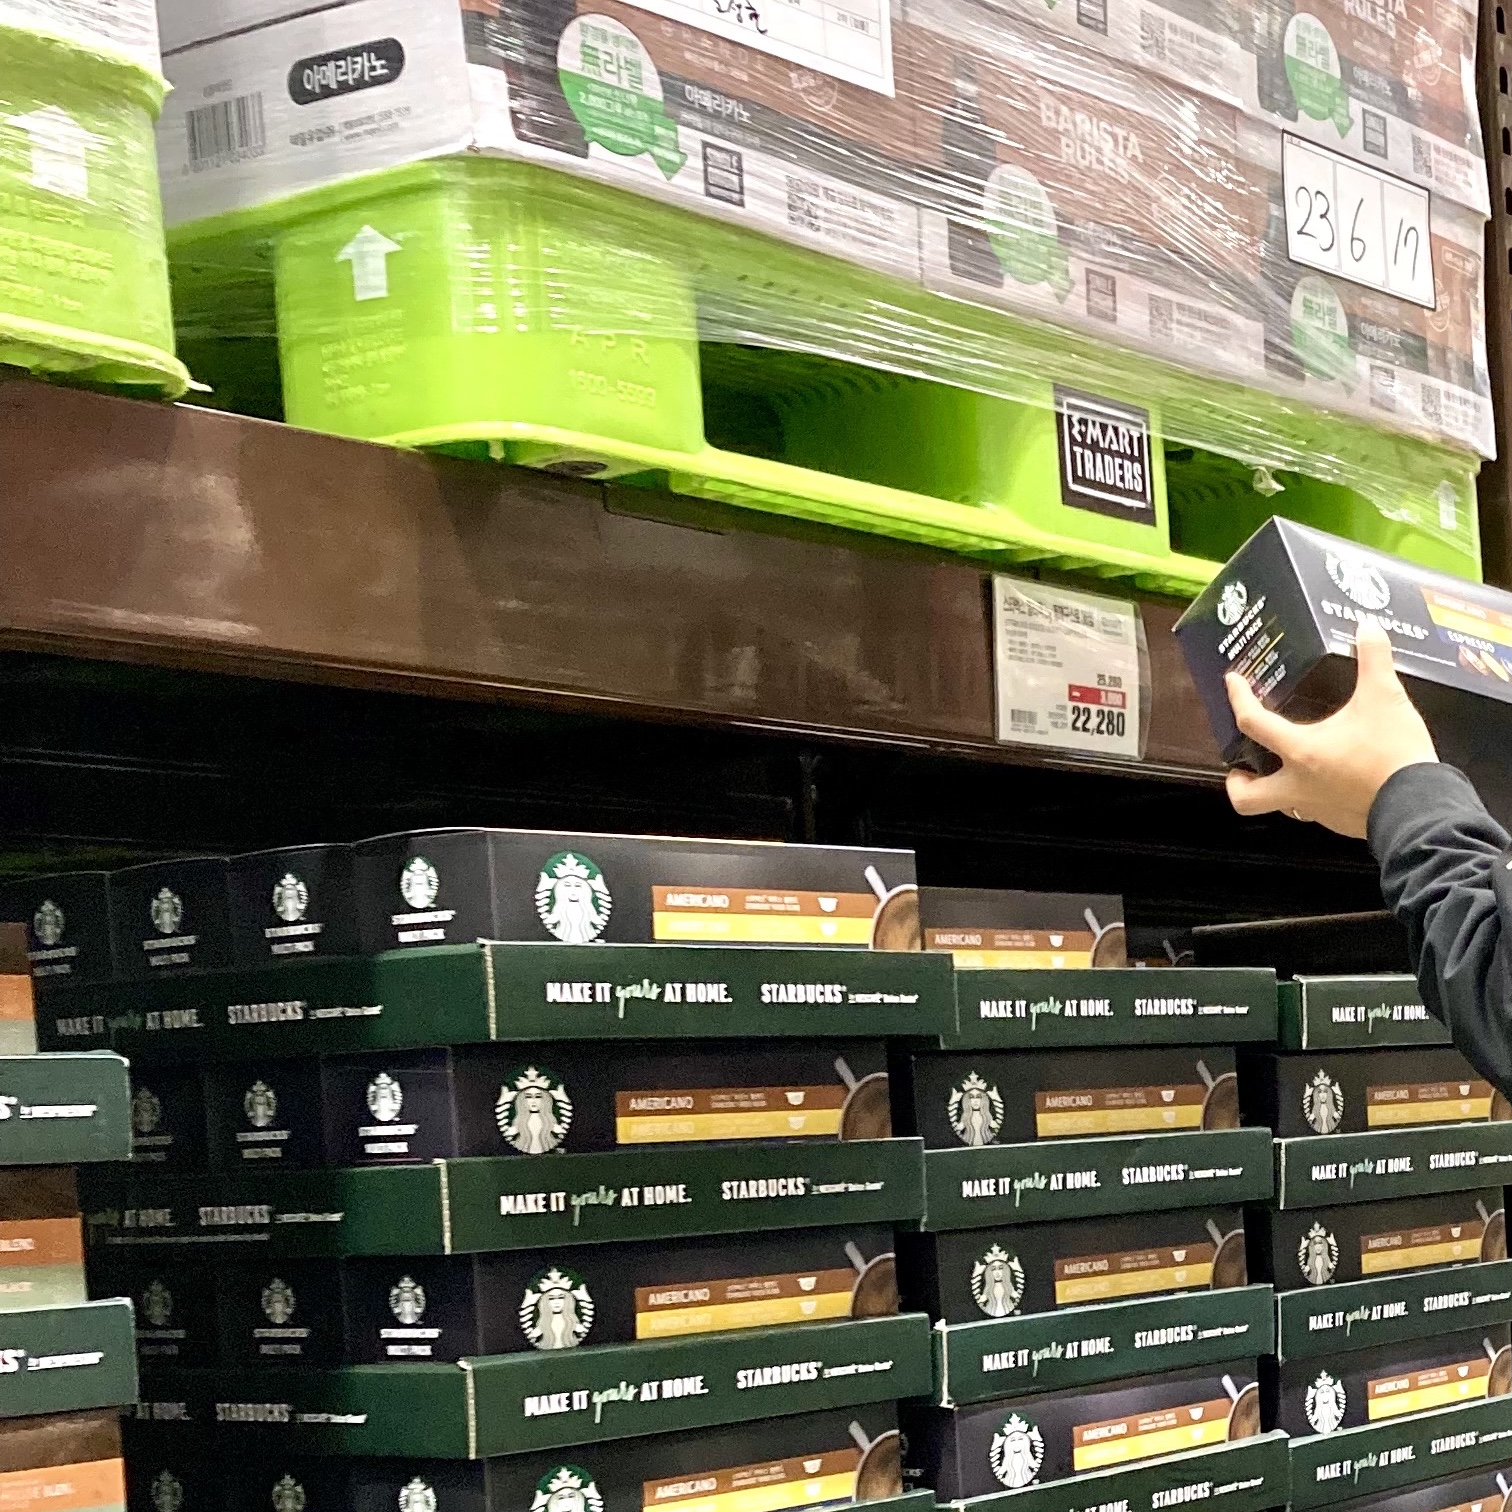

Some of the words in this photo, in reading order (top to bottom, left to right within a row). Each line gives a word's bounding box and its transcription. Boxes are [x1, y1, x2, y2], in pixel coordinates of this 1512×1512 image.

[302, 51, 389, 93] 아메리카노
[1039, 98, 1144, 163] BARISTA
[1295, 186, 1335, 252] 23
[1350, 197, 1366, 262] 6
[1073, 446, 1143, 493] TRADERS
[1218, 596, 1265, 655] STARBUCKS
[1071, 705, 1126, 737] 22,280
[934, 932, 982, 947] AMERICANO
[547, 983, 592, 1003] MAKE
[596, 983, 612, 1003] IT
[664, 982, 682, 1002] AT
[685, 983, 733, 1003] HOME.
[761, 983, 845, 1003] STARBUCKS
[980, 1000, 1013, 1018] MAKE
[1015, 1000, 1026, 1018] IT
[1065, 999, 1077, 1017] AT
[1080, 998, 1113, 1017] HOME.
[1135, 998, 1193, 1016] STARBUCKS
[629, 1095, 693, 1111] AMERICANO
[1045, 1094, 1093, 1108] AMERICANO
[1312, 1164, 1336, 1180] MAKE
[1339, 1163, 1347, 1178] IT
[1376, 1159, 1386, 1174] AT
[1388, 1156, 1413, 1173] HOME.
[1430, 1150, 1474, 1170] STARBUCKS
[500, 1193, 547, 1215] MAKE
[551, 1191, 565, 1212] IT
[621, 1187, 639, 1207] AT
[644, 1184, 692, 1206] HOME.
[722, 1177, 807, 1200] STARBUCKS
[648, 1288, 710, 1305] AMERICANO
[983, 1351, 1015, 1372] MAKE
[1018, 1349, 1029, 1367] IT
[1065, 1341, 1079, 1359] AT
[1081, 1336, 1114, 1357] HOME.
[1135, 1324, 1193, 1348] STARBUCKS
[525, 1392, 570, 1417] MAKE
[573, 1390, 589, 1410] IT
[640, 1381, 659, 1402] AT
[662, 1375, 709, 1399] HOME.
[737, 1361, 820, 1389] STARBUCKS
